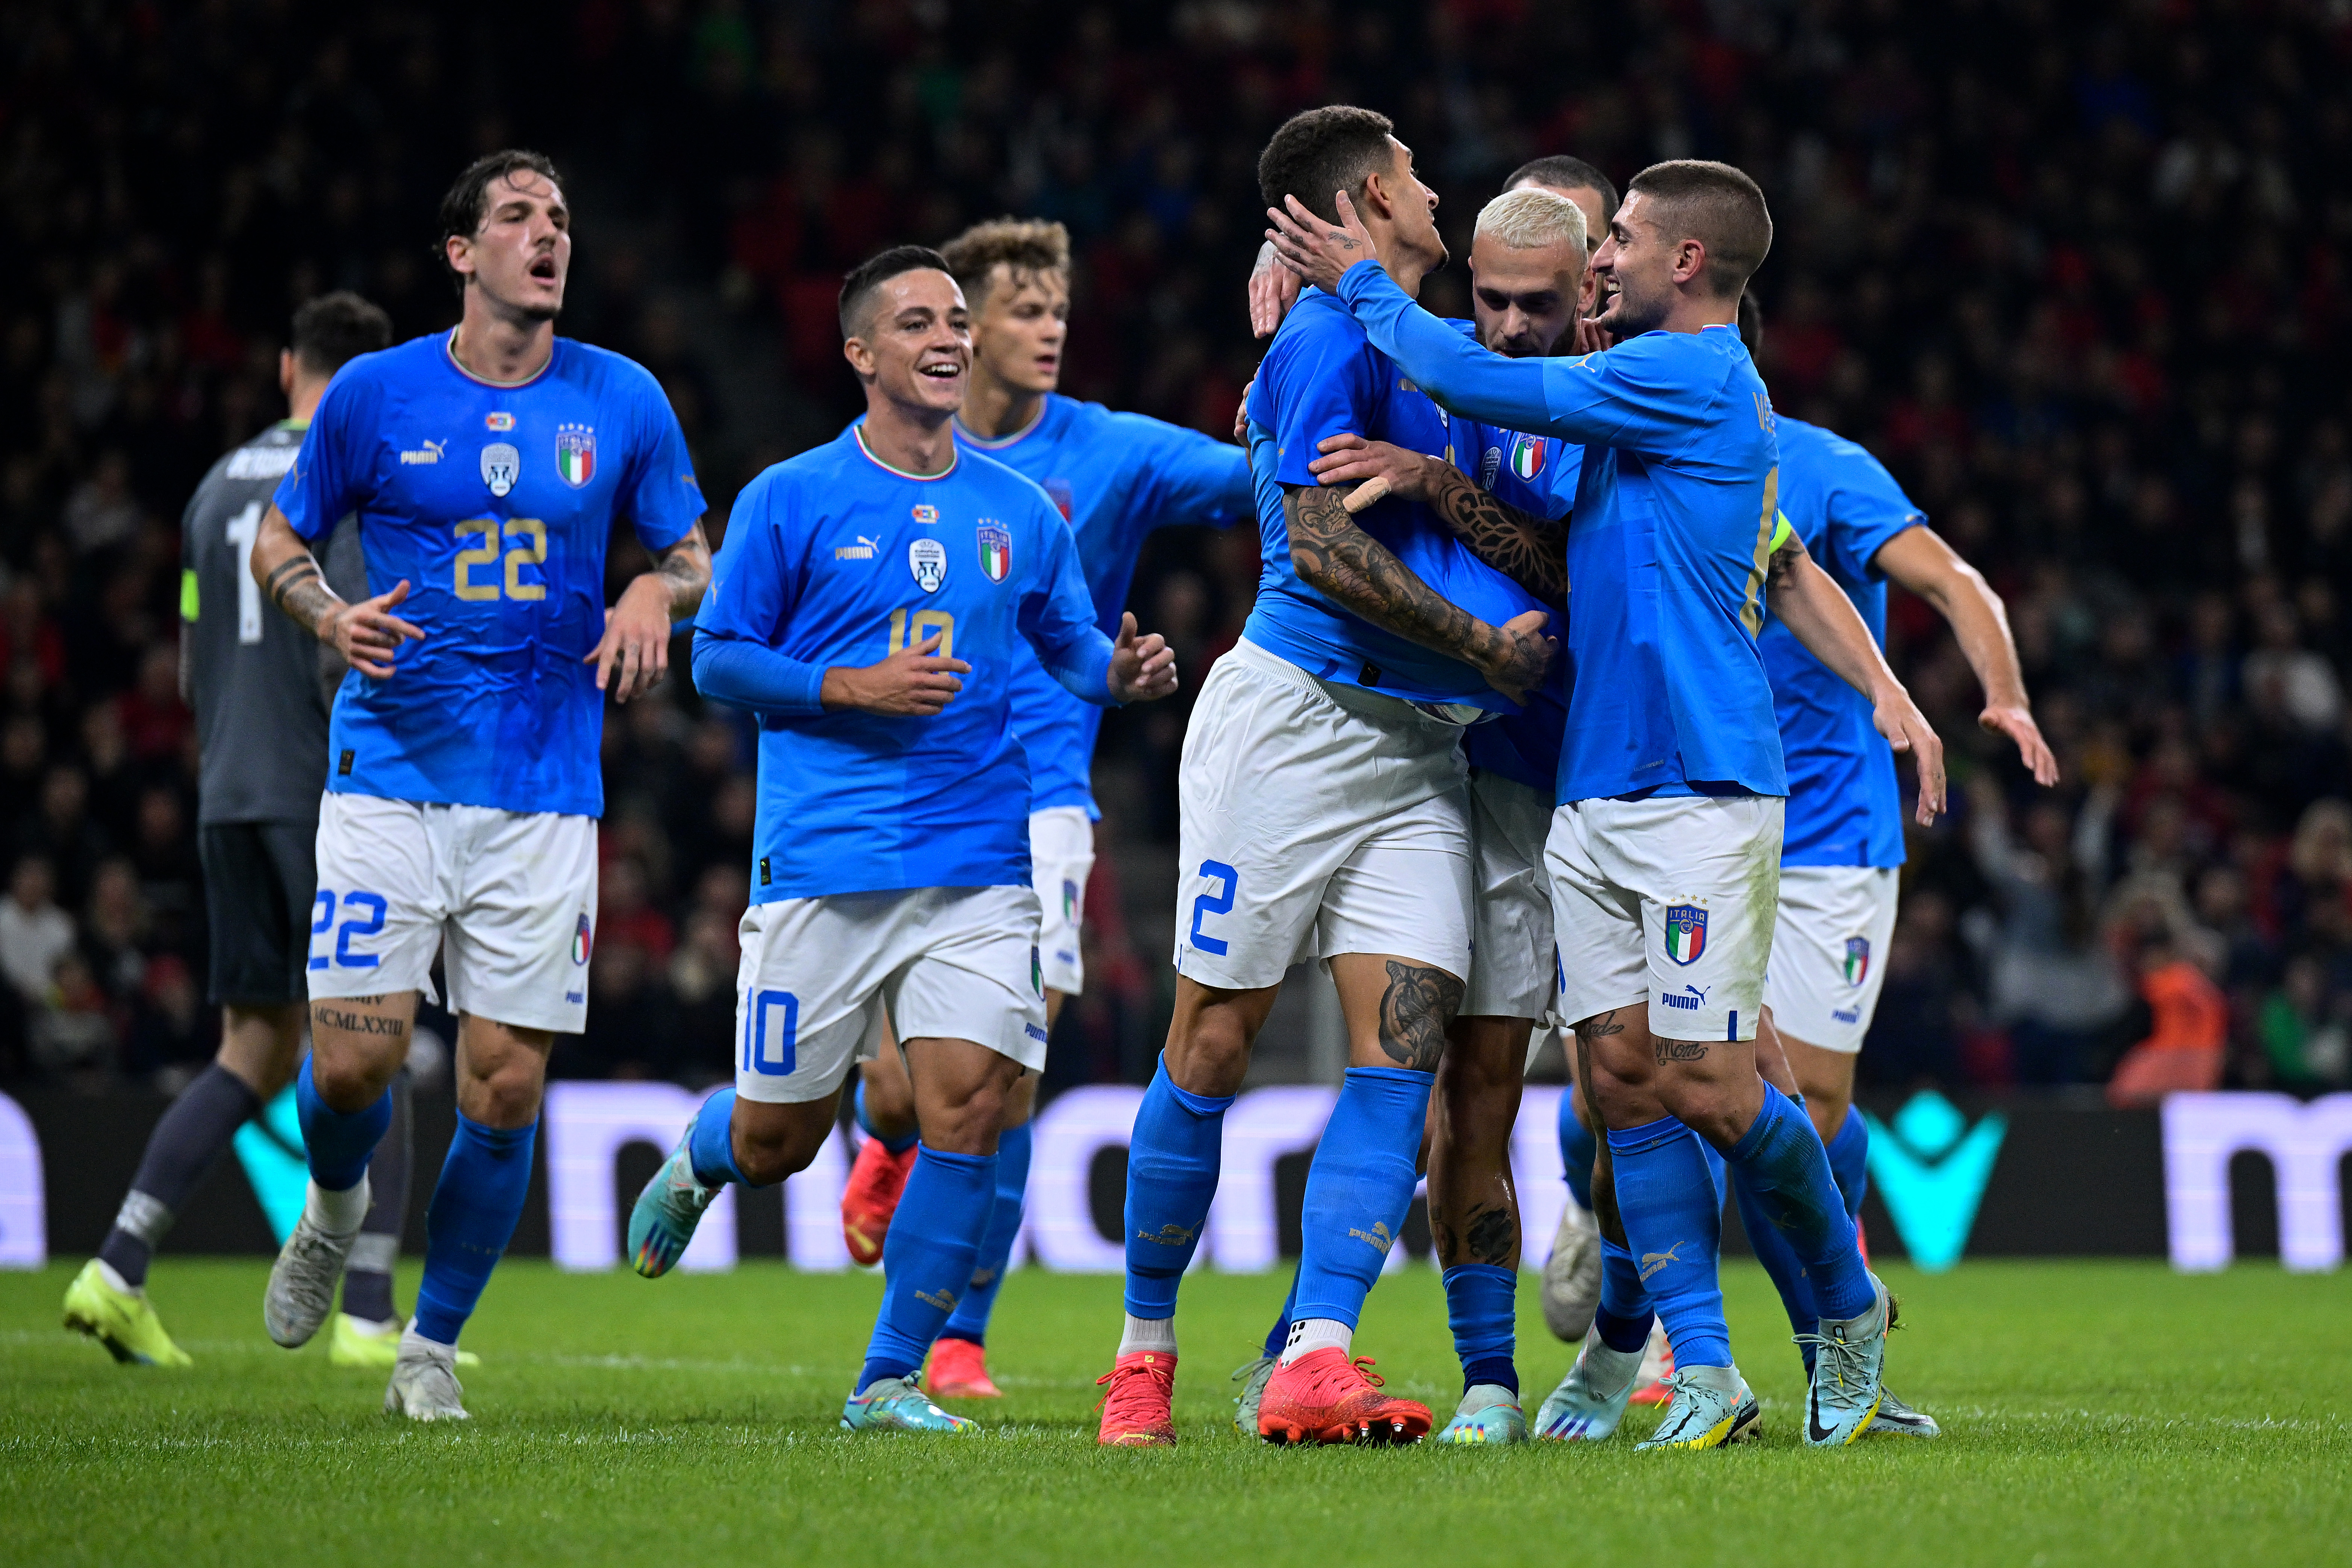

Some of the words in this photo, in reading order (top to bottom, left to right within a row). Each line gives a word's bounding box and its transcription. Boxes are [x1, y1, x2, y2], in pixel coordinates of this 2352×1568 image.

[454, 519, 547, 601] 22
[835, 546, 873, 560] PUMA
[889, 608, 954, 675] 10
[309, 889, 387, 971] 22
[1190, 859, 1238, 957] 2
[1670, 909, 1705, 922] ITALIA
[744, 986, 798, 1076] 10
[1025, 1022, 1047, 1043] PUM
[1662, 992, 1698, 1010] PUMA
